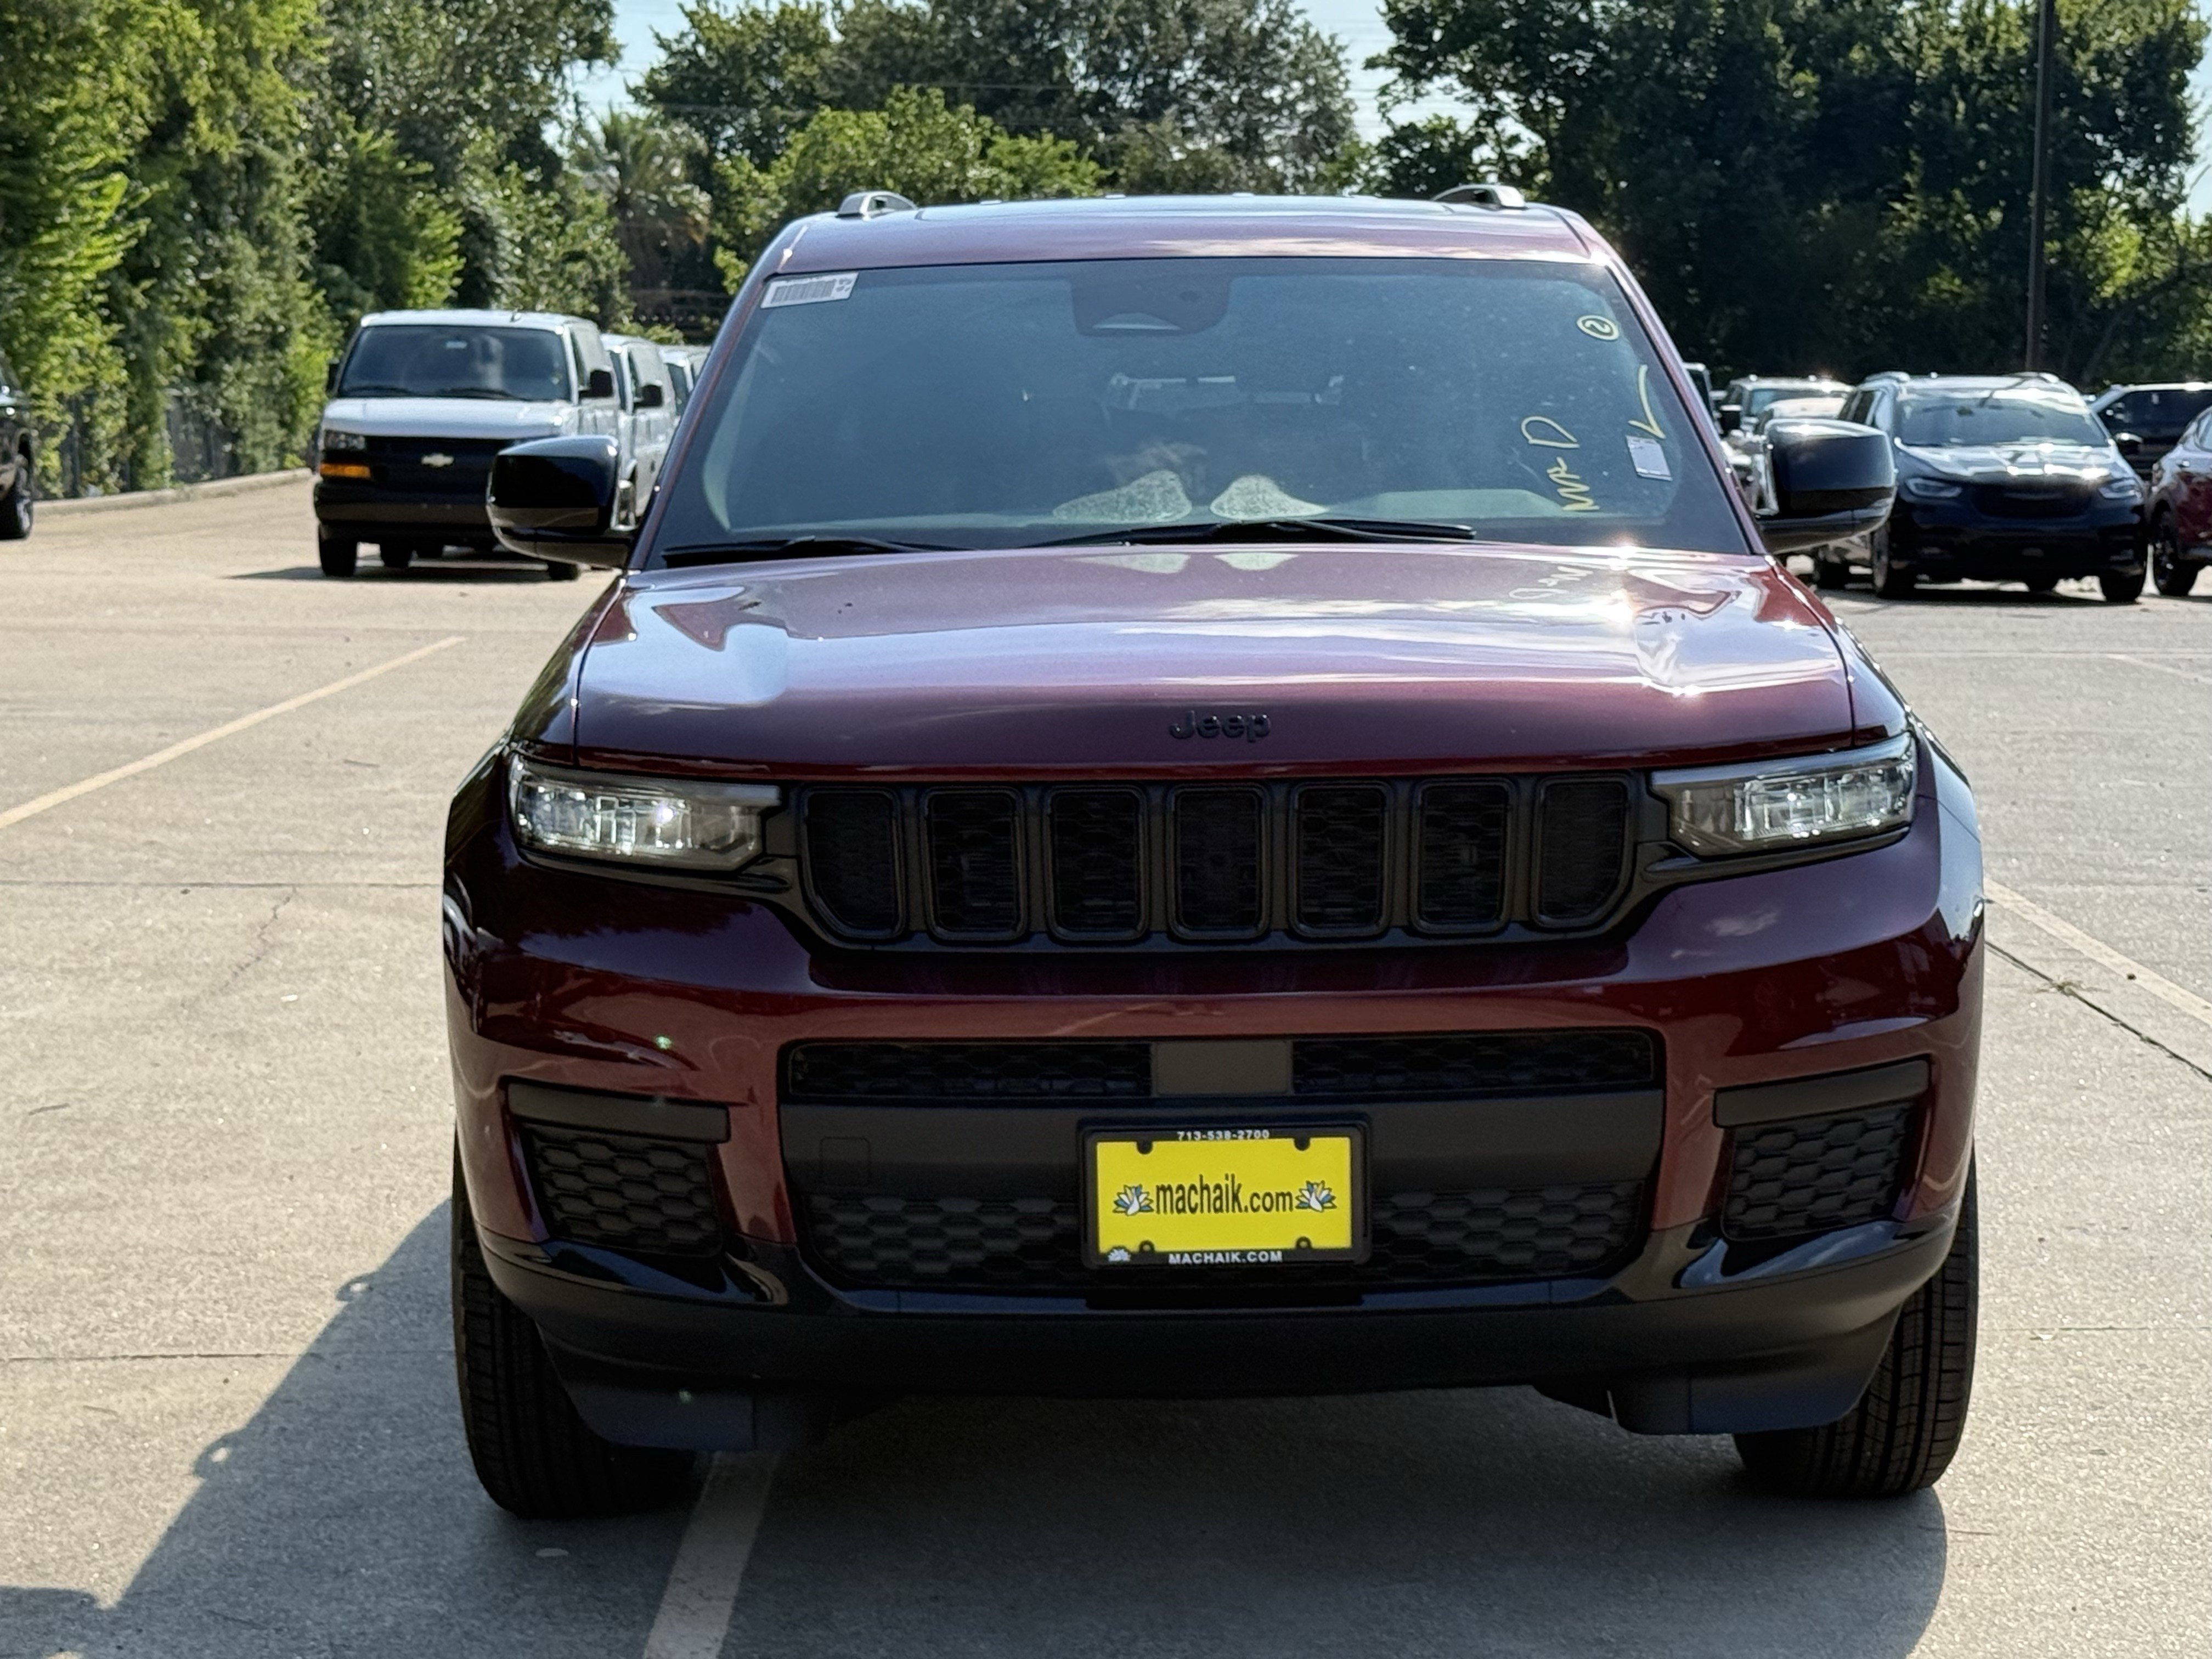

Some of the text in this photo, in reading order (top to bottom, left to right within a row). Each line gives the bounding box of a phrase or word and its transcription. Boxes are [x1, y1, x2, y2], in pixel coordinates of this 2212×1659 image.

[1169, 710, 1271, 743] Jeep
[1177, 1130, 1270, 1141] 713-538-2700
[1156, 1173, 1293, 1215] machaik.com
[1169, 1251, 1283, 1265] MACHAIK.COM
